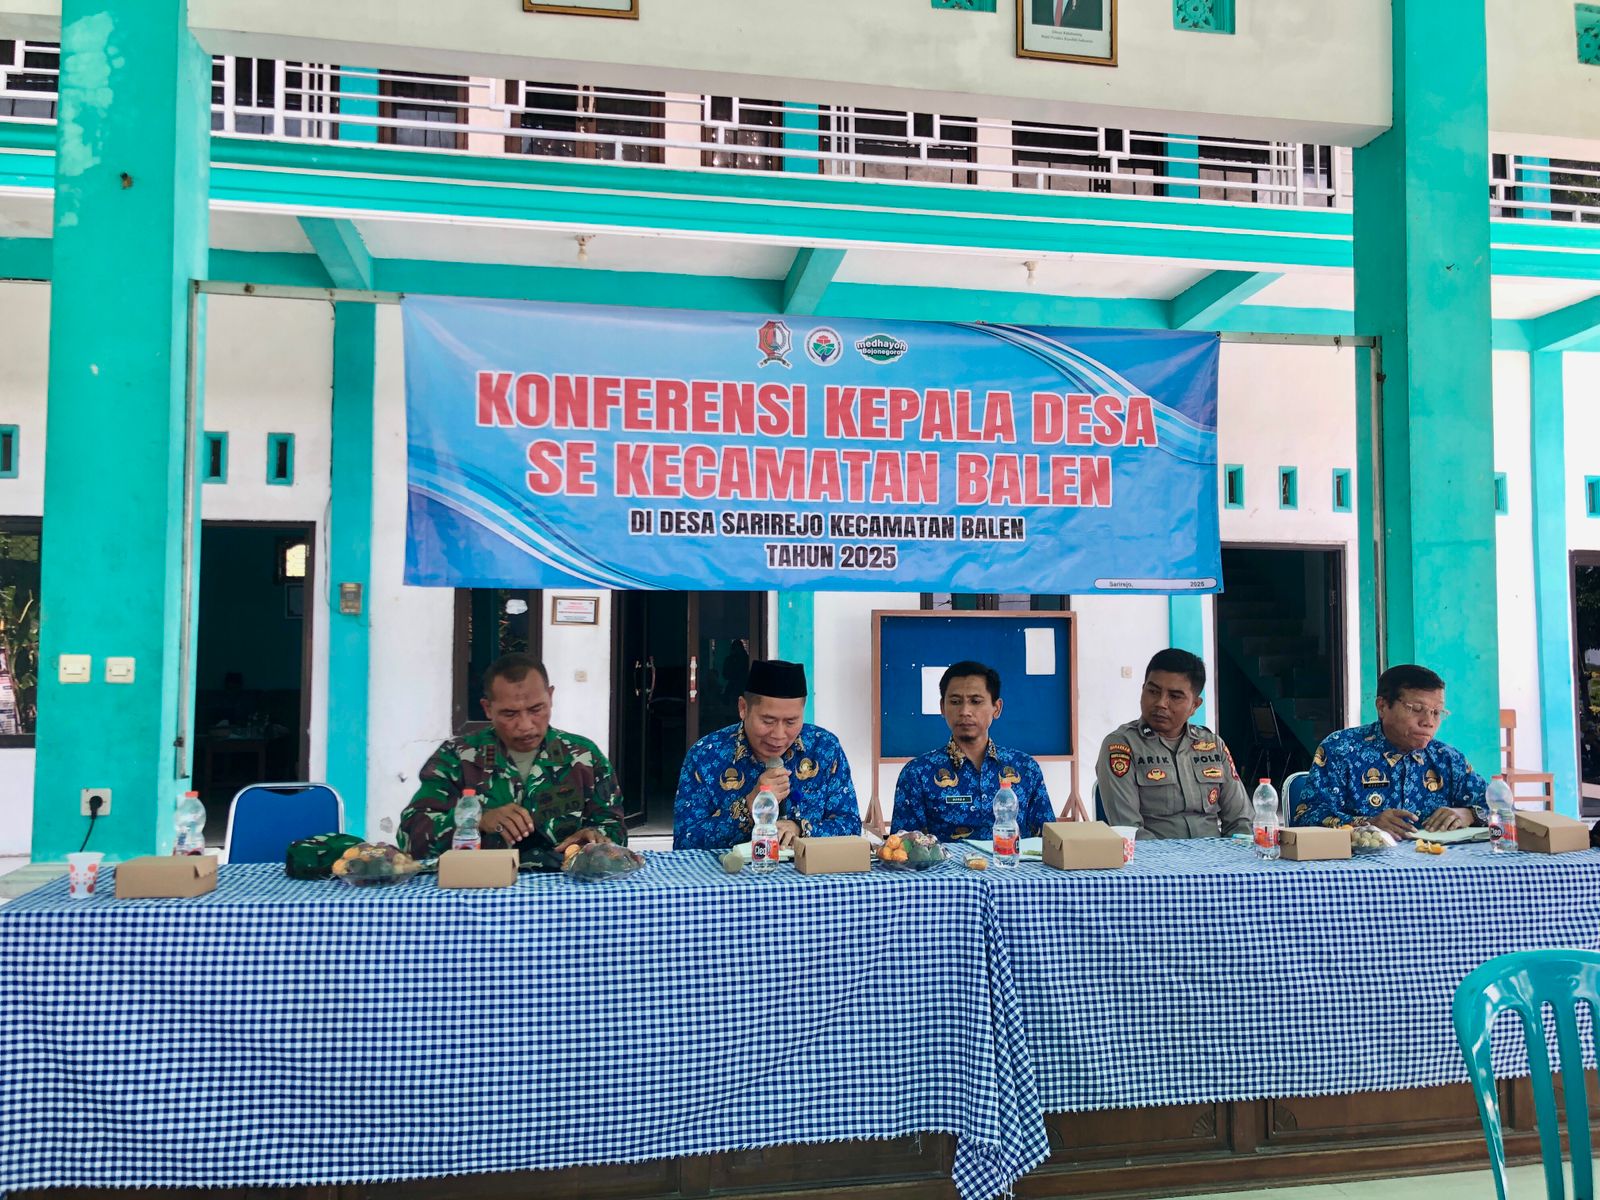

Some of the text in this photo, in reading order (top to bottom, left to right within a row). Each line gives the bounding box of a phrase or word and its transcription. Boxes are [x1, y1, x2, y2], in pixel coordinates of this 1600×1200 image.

[856, 338, 907, 351] medhayoh
[476, 371, 1158, 448] KONFERENSI KEPALA DESA
[527, 440, 1113, 508] SE KECAMATAN BALEN
[630, 508, 1025, 541] DI DESA SARIREJO KECAMATAN BALEN
[765, 543, 898, 570] TAHUN 2025
[1137, 755, 1170, 765] ARIK
